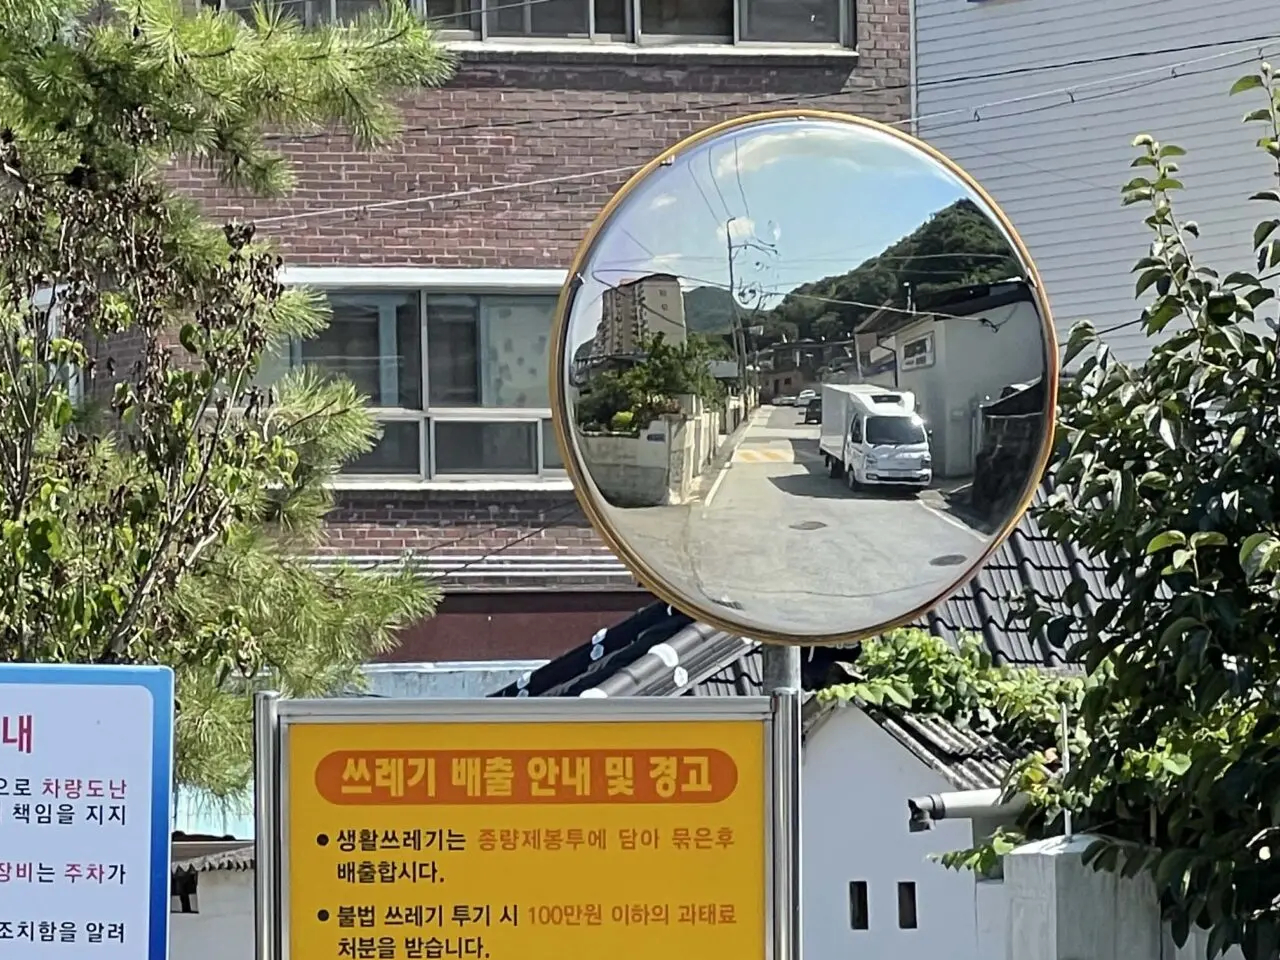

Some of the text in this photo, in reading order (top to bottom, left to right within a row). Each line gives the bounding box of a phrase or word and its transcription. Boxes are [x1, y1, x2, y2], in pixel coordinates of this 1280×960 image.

[41, 777, 128, 800] 차량도난
[341, 756, 713, 797] 쓰레기 배출 안내 및 경고
[11, 802, 76, 825] 책임을
[85, 804, 126, 827] 지지
[335, 827, 467, 853] 생활쓰레기는
[618, 827, 661, 851] 담아
[63, 863, 127, 886] 주차가
[335, 859, 445, 885] 배출합시다.
[336, 902, 737, 930] 불법 쓰레기 투기 시 100만원 이하의 과태료
[85, 922, 125, 944] 알려
[336, 935, 491, 960] 처분을 받습니다.
